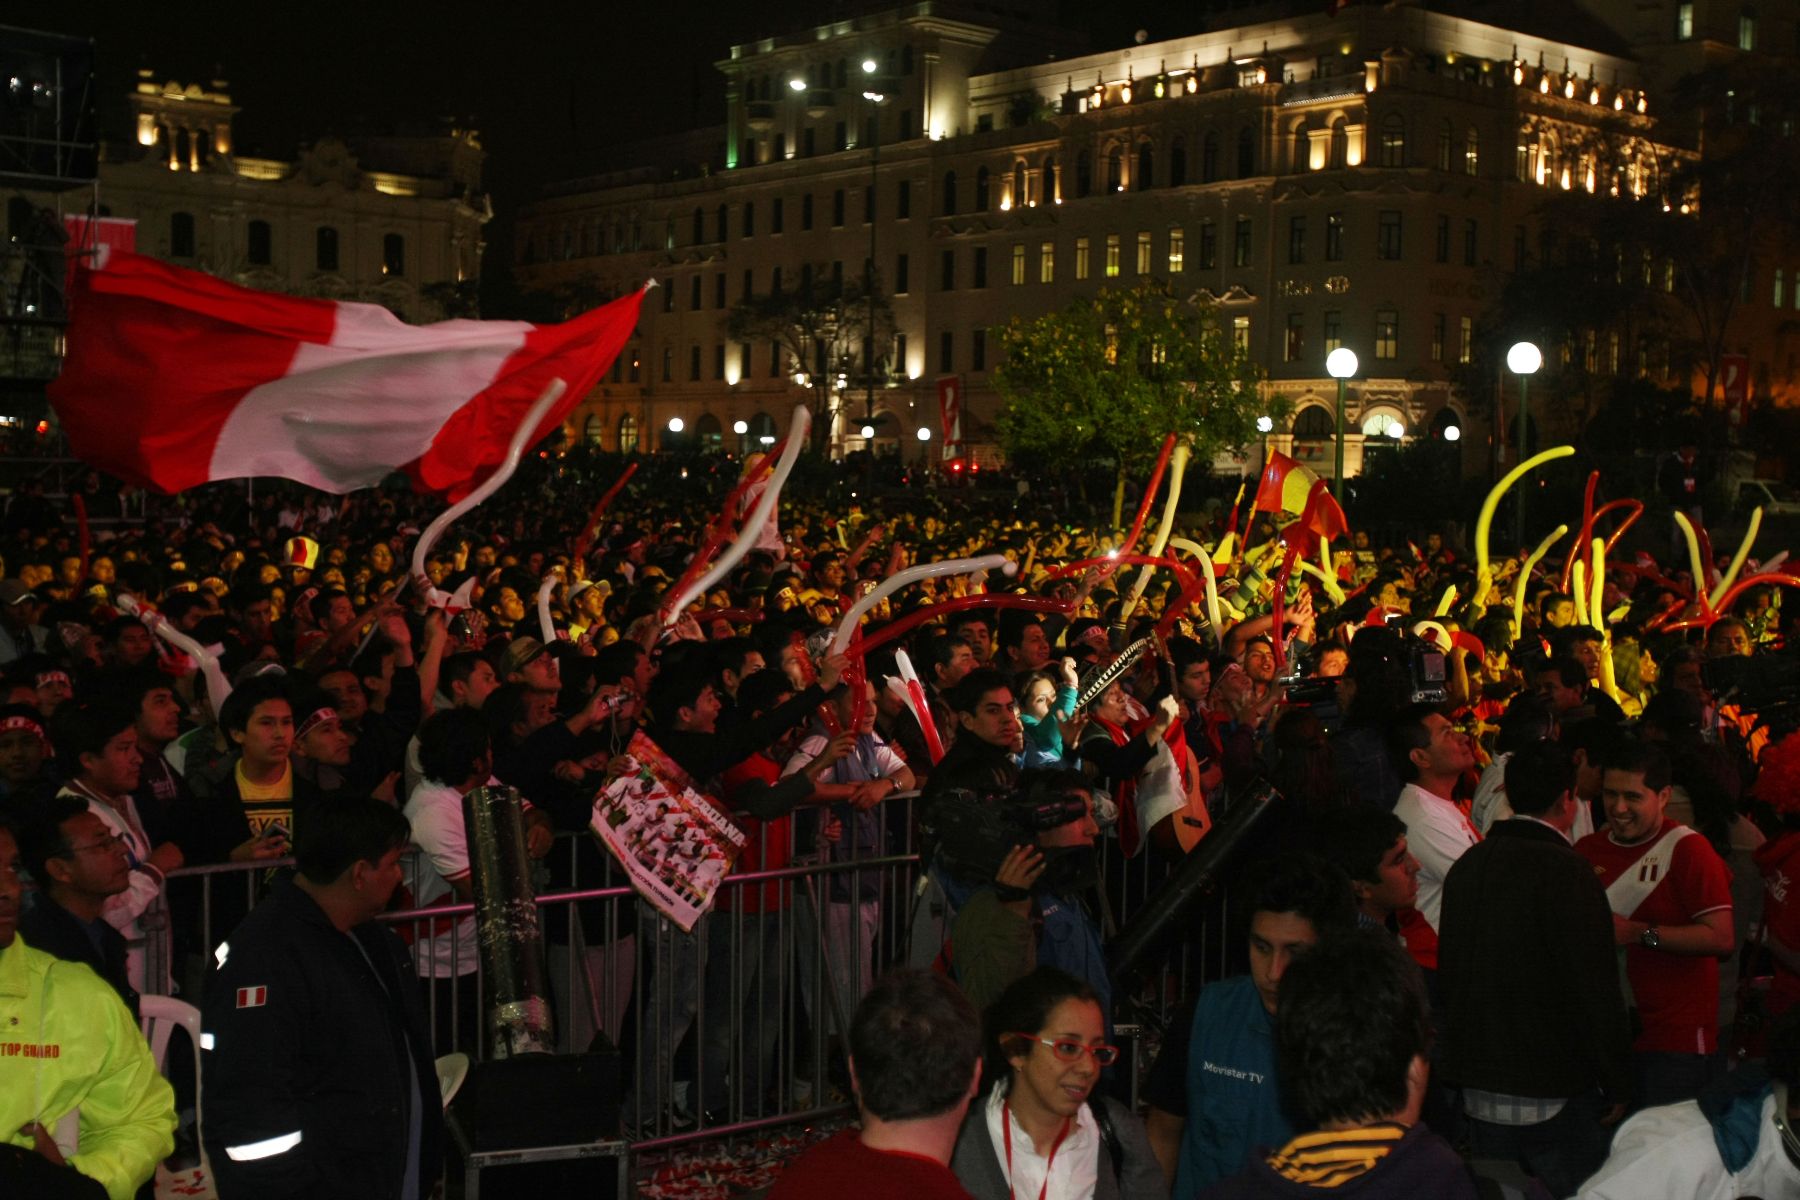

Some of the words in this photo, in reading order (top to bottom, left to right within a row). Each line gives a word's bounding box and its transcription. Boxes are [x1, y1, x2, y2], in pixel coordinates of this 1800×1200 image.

[681, 786, 746, 847] PERUANA
[0, 1043, 21, 1057] TOP
[1203, 1060, 1247, 1080] Movistar
[1249, 1072, 1264, 1085] TV
